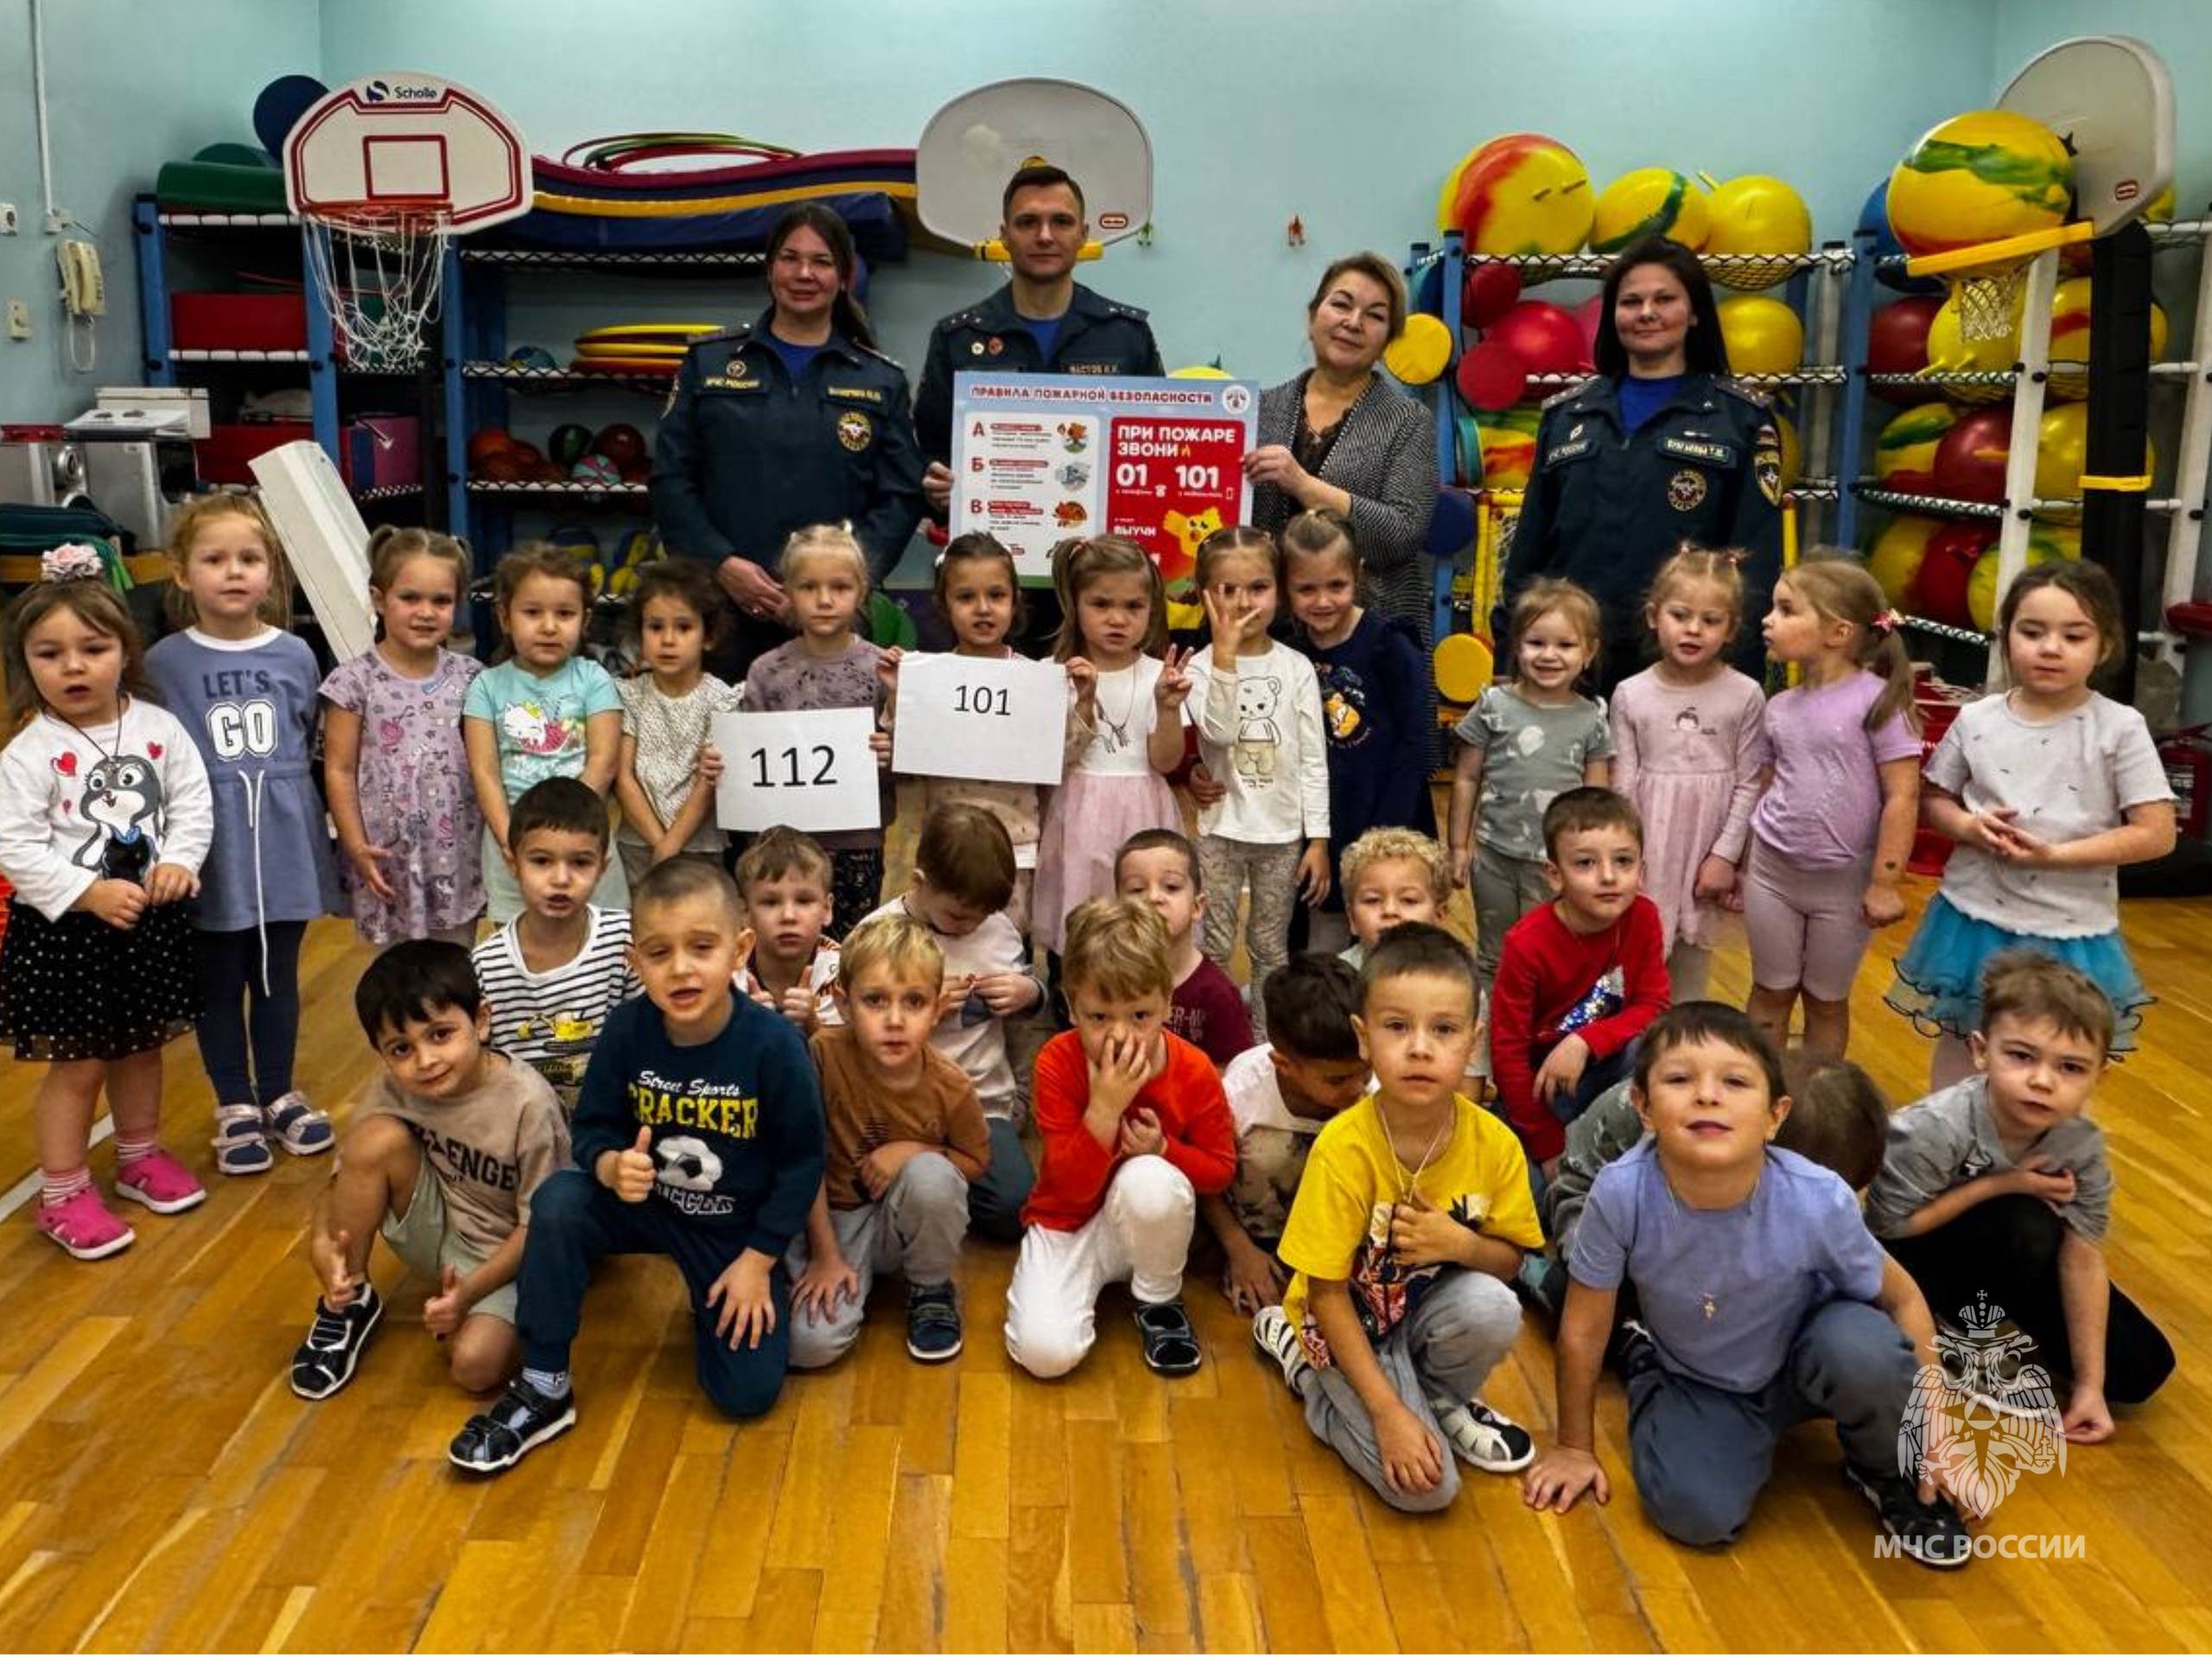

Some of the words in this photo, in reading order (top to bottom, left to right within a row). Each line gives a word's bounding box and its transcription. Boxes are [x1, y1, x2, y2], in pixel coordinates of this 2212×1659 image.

[971, 386, 1029, 397] ПРАВИЛА
[1034, 386, 1105, 400] ПОЖАРНОЙ
[1109, 390, 1212, 404] БЕЗОПАСНОСТИ
[972, 421, 984, 437] А
[1117, 425, 1154, 441] ПРИ
[1159, 427, 1236, 443] ПОЖАРЕ
[1117, 442, 1179, 457] ЗВОНИ
[971, 457, 983, 472] Б
[1116, 462, 1147, 486] 01
[1175, 464, 1219, 489] 101
[970, 499, 982, 513] В
[203, 670, 270, 698] LET'S
[954, 684, 1011, 716] 101
[206, 699, 277, 761] GO
[751, 745, 837, 788] 112
[638, 1071, 683, 1093] Street
[687, 1078, 741, 1097] Sports
